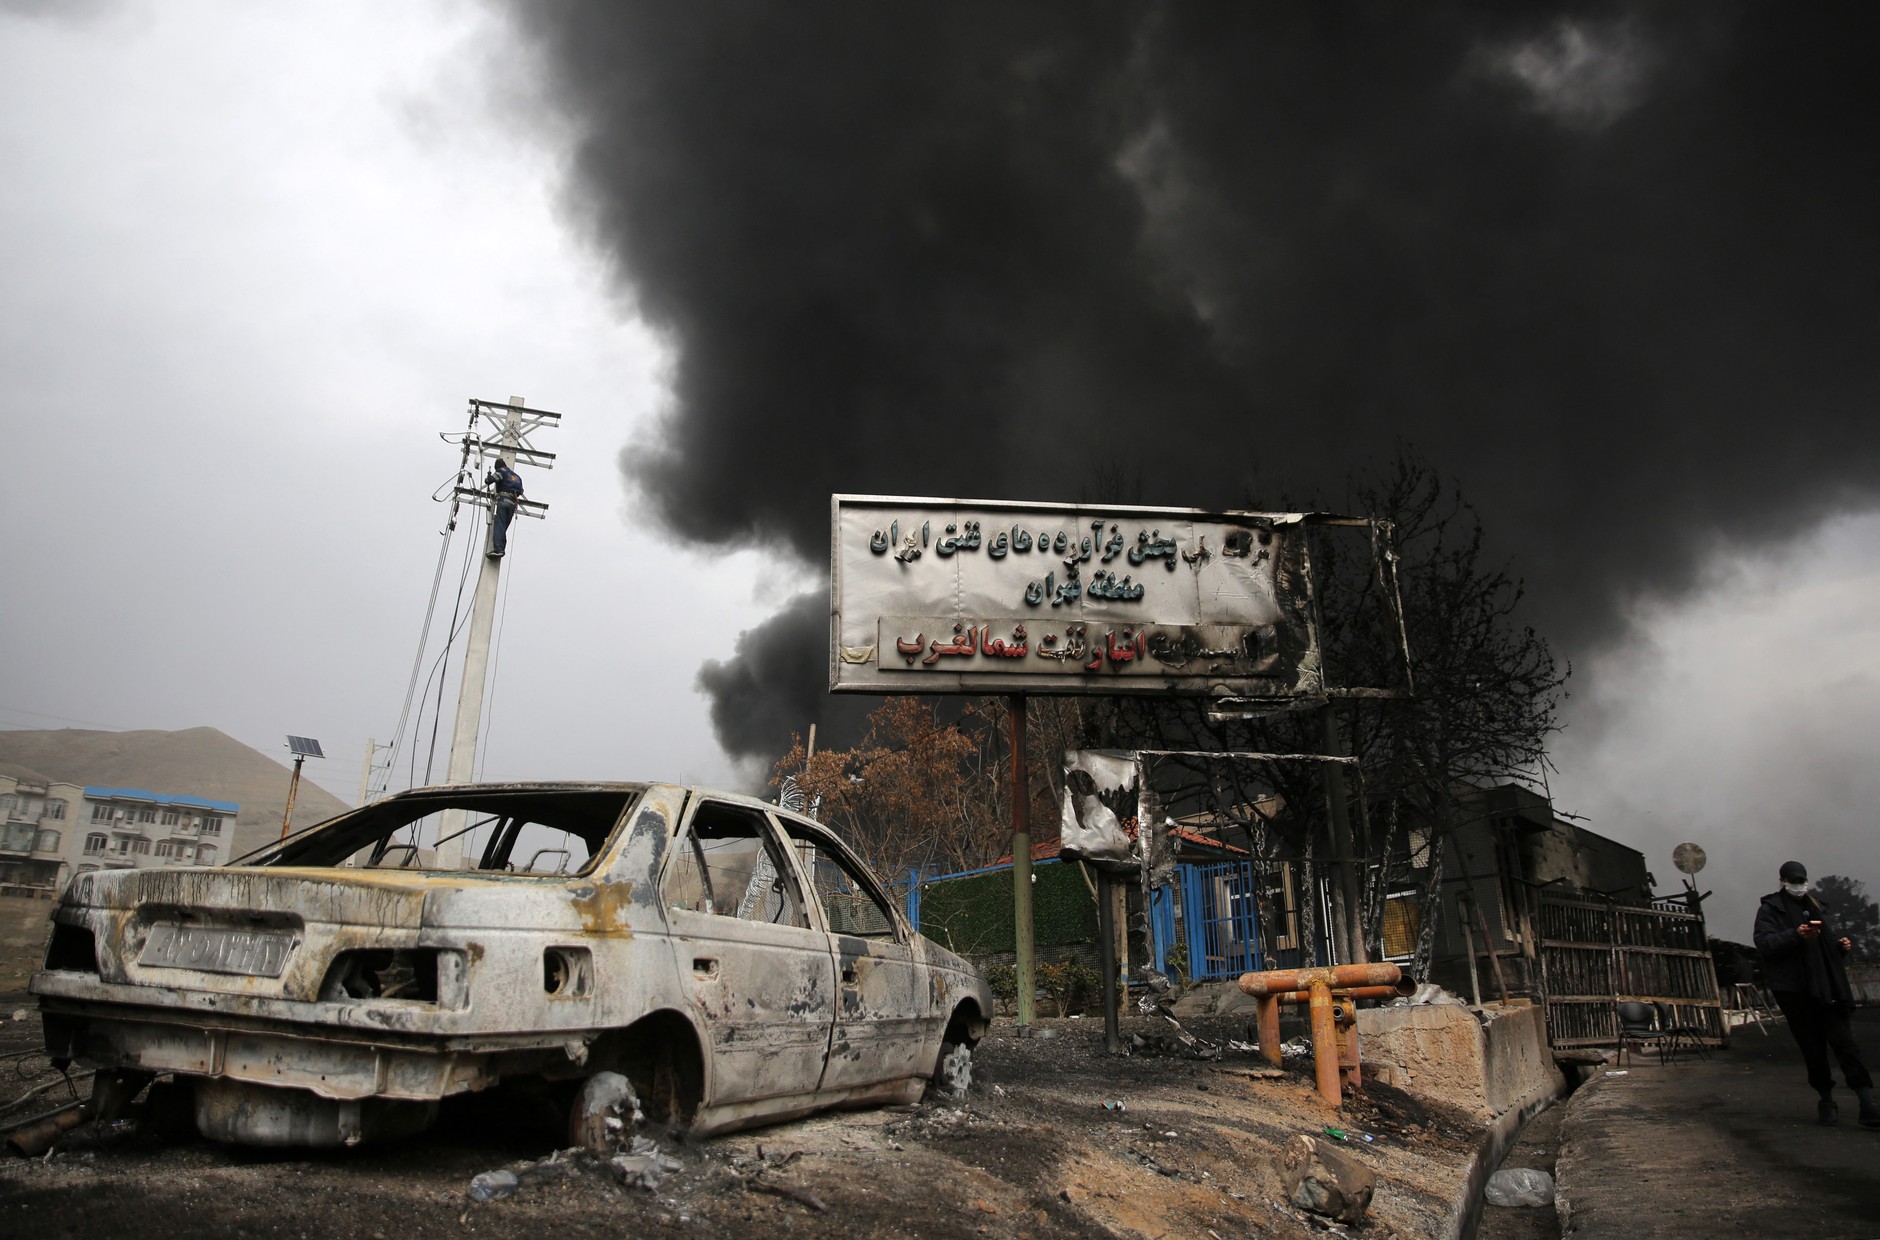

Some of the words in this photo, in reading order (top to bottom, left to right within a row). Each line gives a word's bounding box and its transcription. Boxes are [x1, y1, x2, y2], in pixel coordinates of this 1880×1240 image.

[935, 520, 982, 557] نفتی
[987, 523, 1033, 559] های
[1128, 529, 1178, 571] پخش
[1024, 569, 1082, 607] تهران
[1037, 625, 1087, 664] نفت
[1084, 626, 1146, 672] انبار
